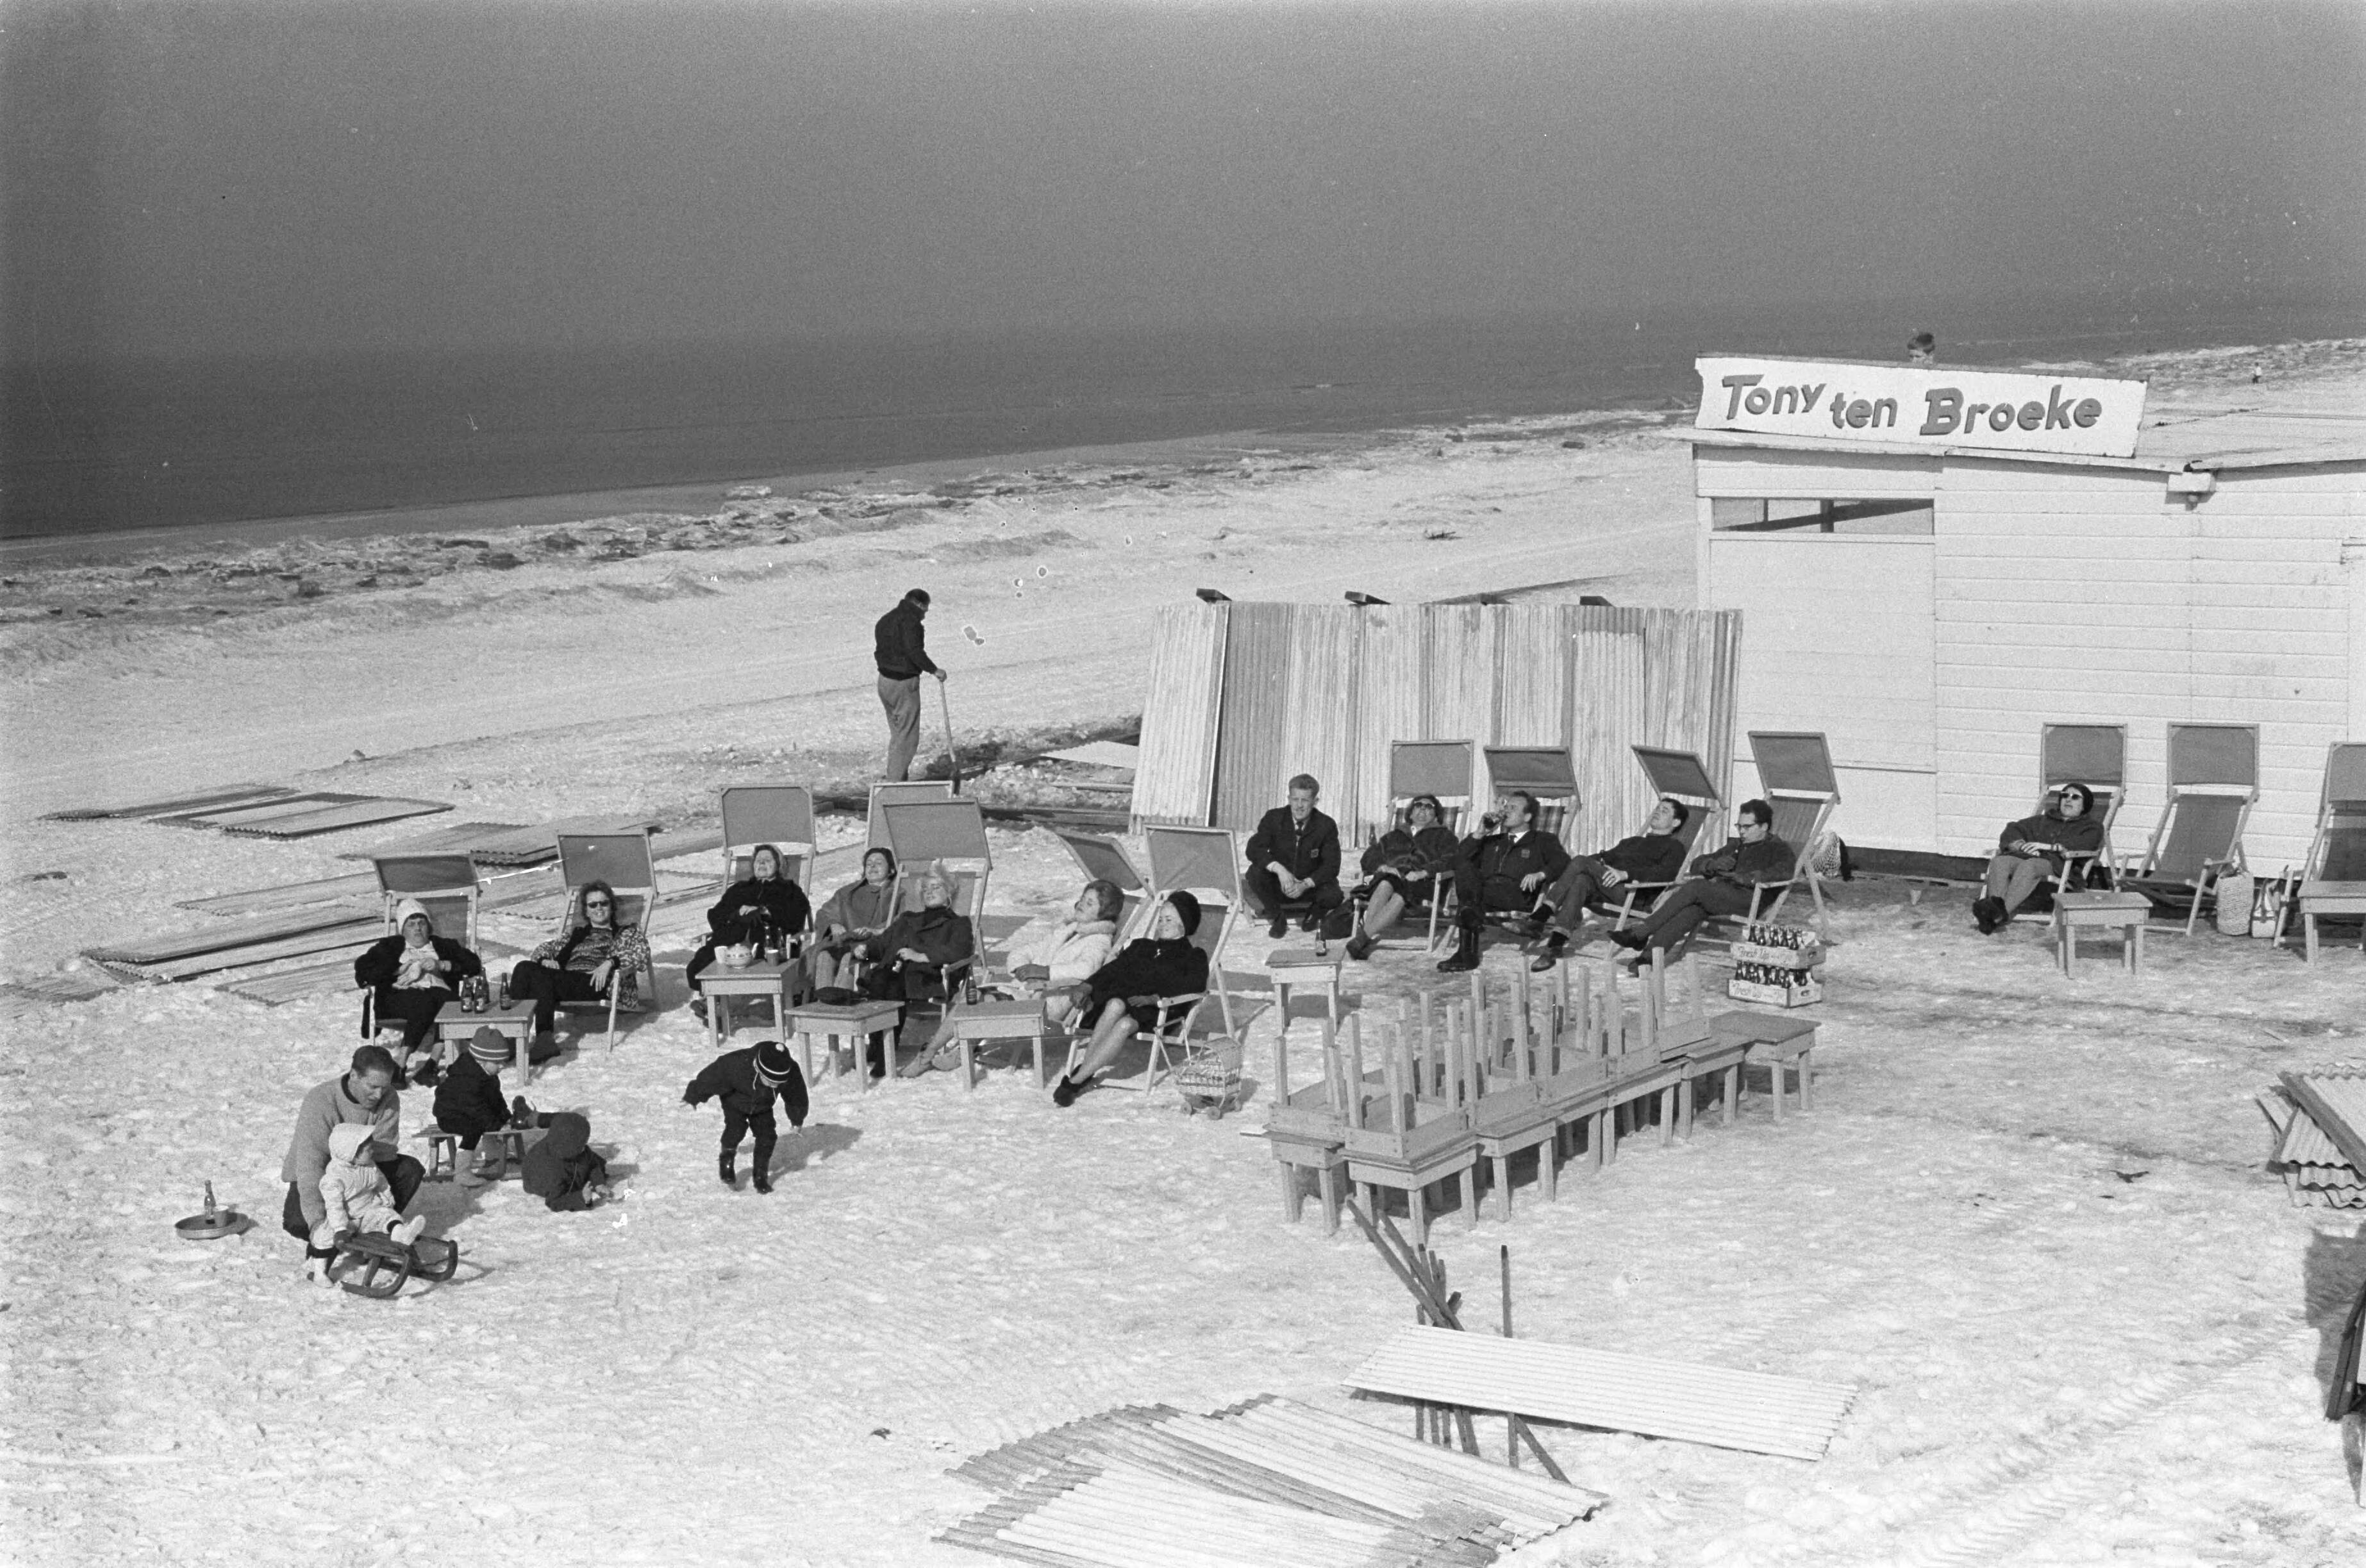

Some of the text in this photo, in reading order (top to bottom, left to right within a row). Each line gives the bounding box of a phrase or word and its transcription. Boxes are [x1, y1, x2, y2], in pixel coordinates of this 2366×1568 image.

[1722, 374, 2103, 437] Tony ten Broeke
